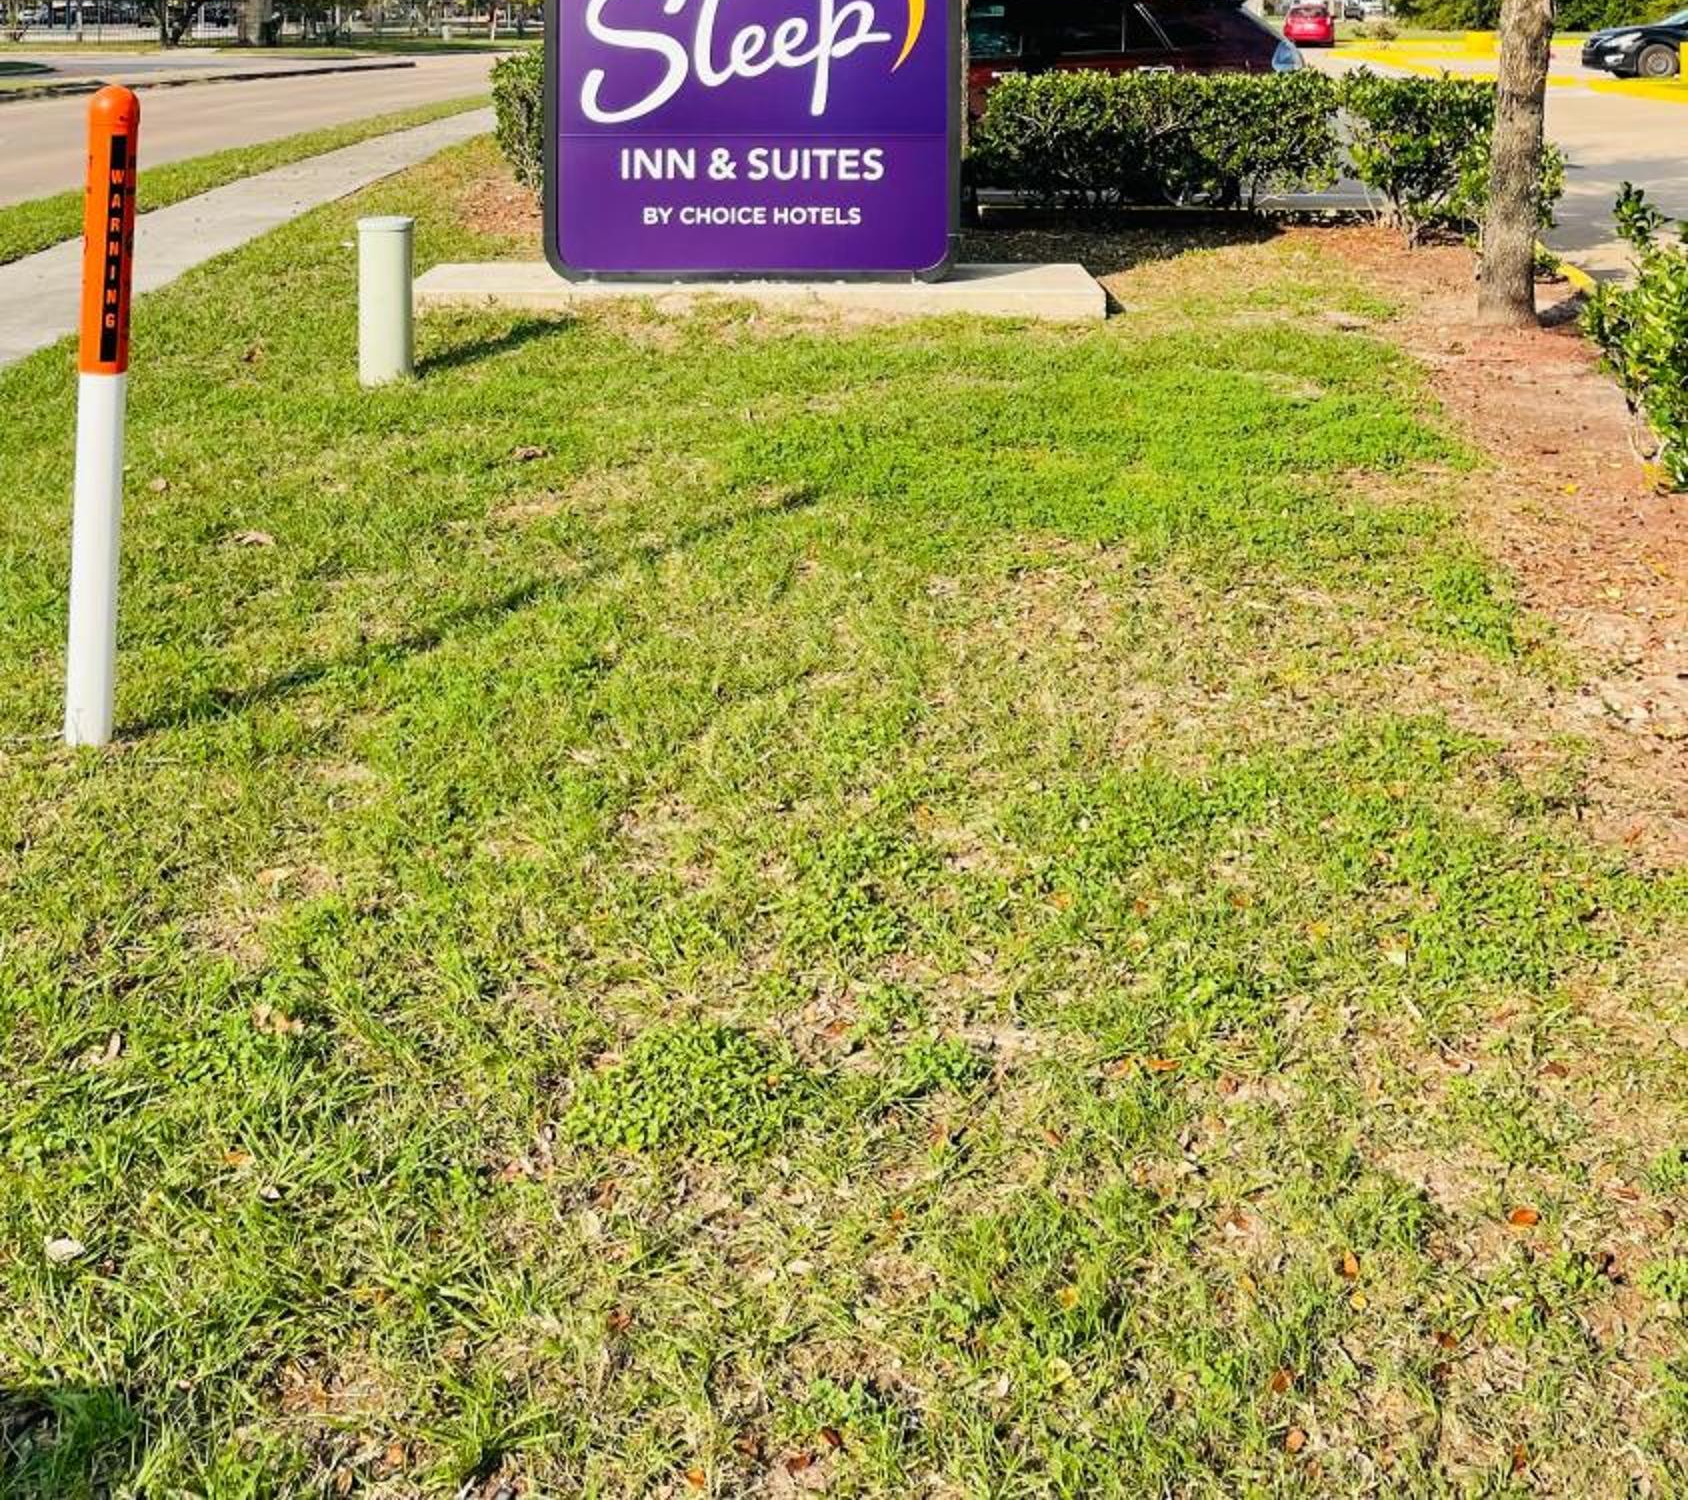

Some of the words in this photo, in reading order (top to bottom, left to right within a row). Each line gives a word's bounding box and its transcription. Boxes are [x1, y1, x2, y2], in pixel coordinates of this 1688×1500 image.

[621, 148, 695, 180] INN
[708, 148, 736, 180] &
[748, 148, 885, 180] SUITES
[643, 207, 673, 225] BY
[680, 207, 767, 225] CHOICE
[774, 207, 861, 225] HOTELS
[105, 169, 126, 328] WARNING
